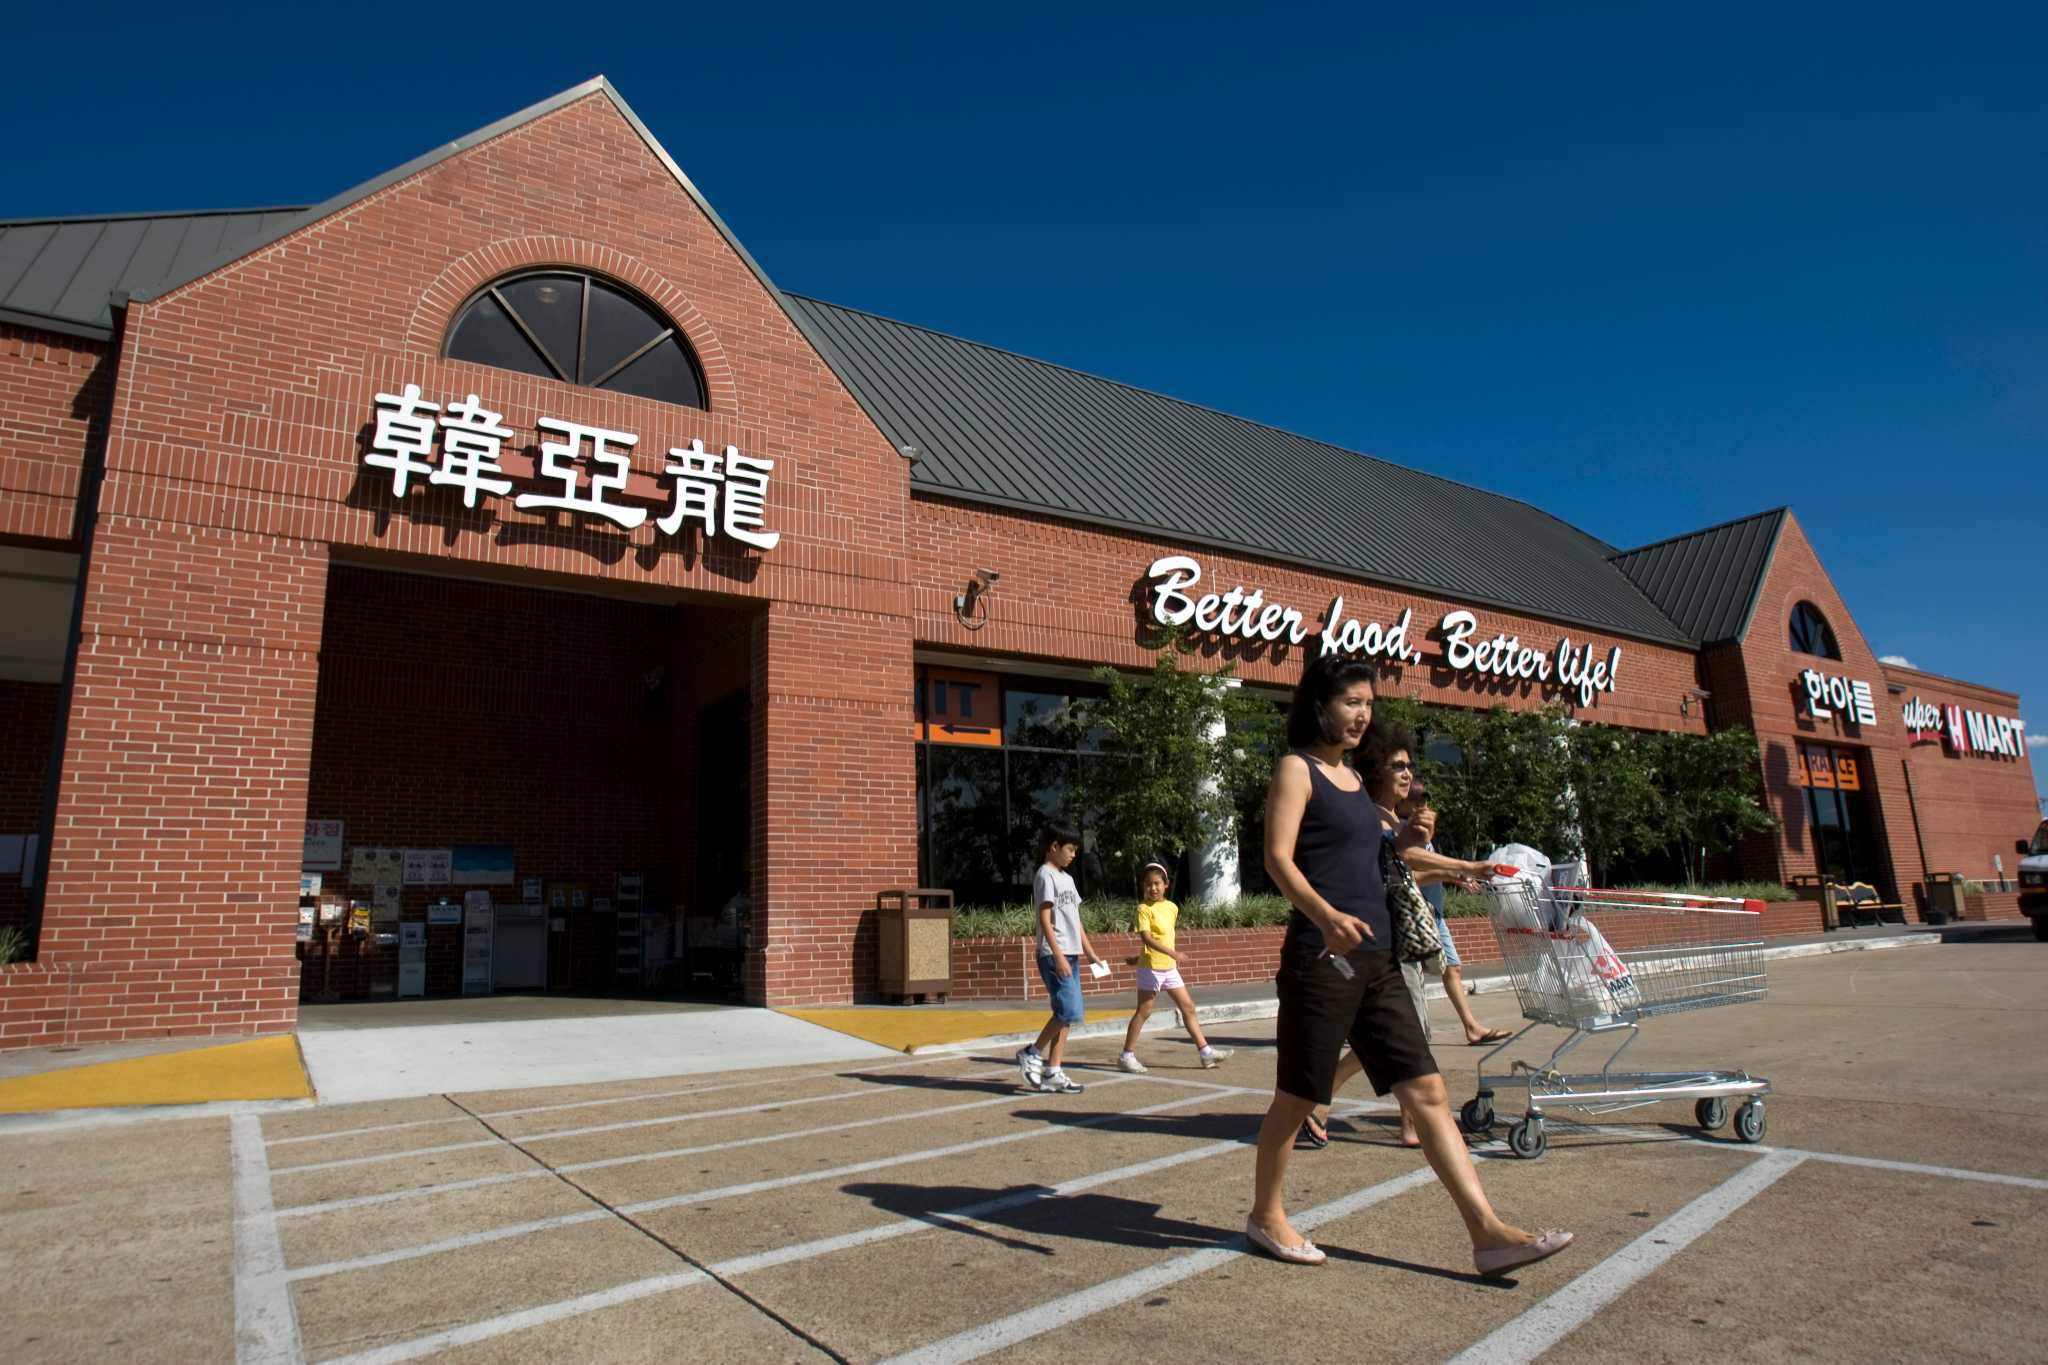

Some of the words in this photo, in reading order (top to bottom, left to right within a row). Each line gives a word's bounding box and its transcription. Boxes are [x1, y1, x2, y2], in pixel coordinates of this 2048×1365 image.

[364, 383, 780, 549] 韓亞龍
[1147, 555, 1308, 644] Better
[1320, 595, 1422, 665] food,
[1442, 610, 1551, 681] Better
[1558, 637, 1622, 708] life!
[918, 679, 981, 717] IT
[1803, 668, 1878, 727] 한아름
[1902, 695, 1944, 742] uper
[1947, 704, 1966, 752] H
[1966, 709, 2025, 758] MART
